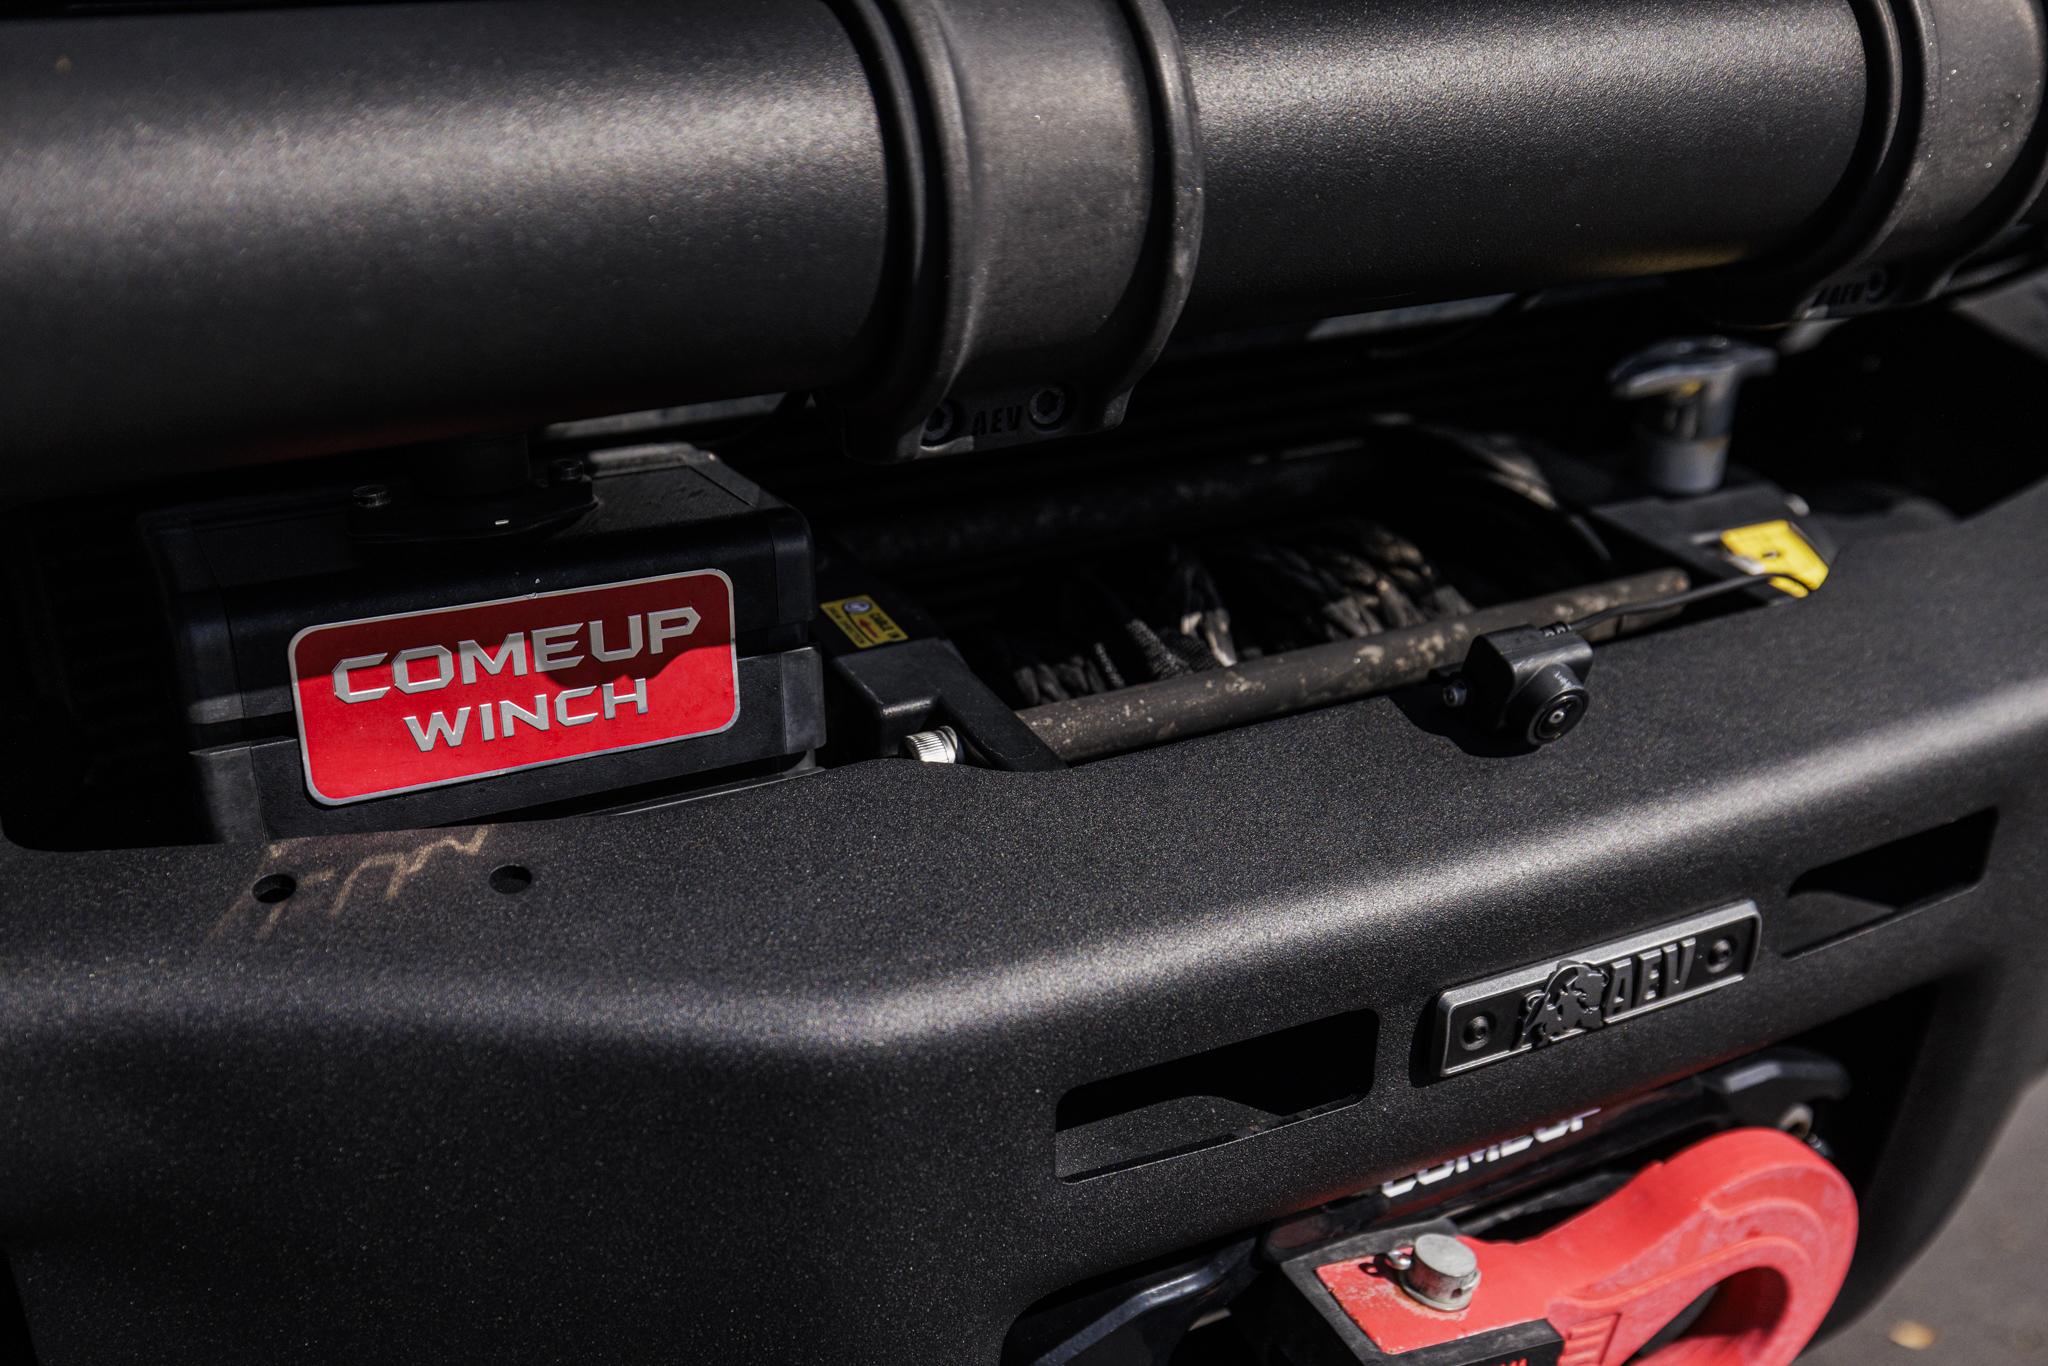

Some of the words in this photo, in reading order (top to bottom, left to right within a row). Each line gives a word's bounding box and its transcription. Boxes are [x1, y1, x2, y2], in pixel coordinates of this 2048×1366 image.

[971, 405, 1023, 436] AEV
[332, 606, 701, 704] COMEUP
[403, 678, 649, 752] WINCH
[1603, 937, 1697, 1019] AEV
